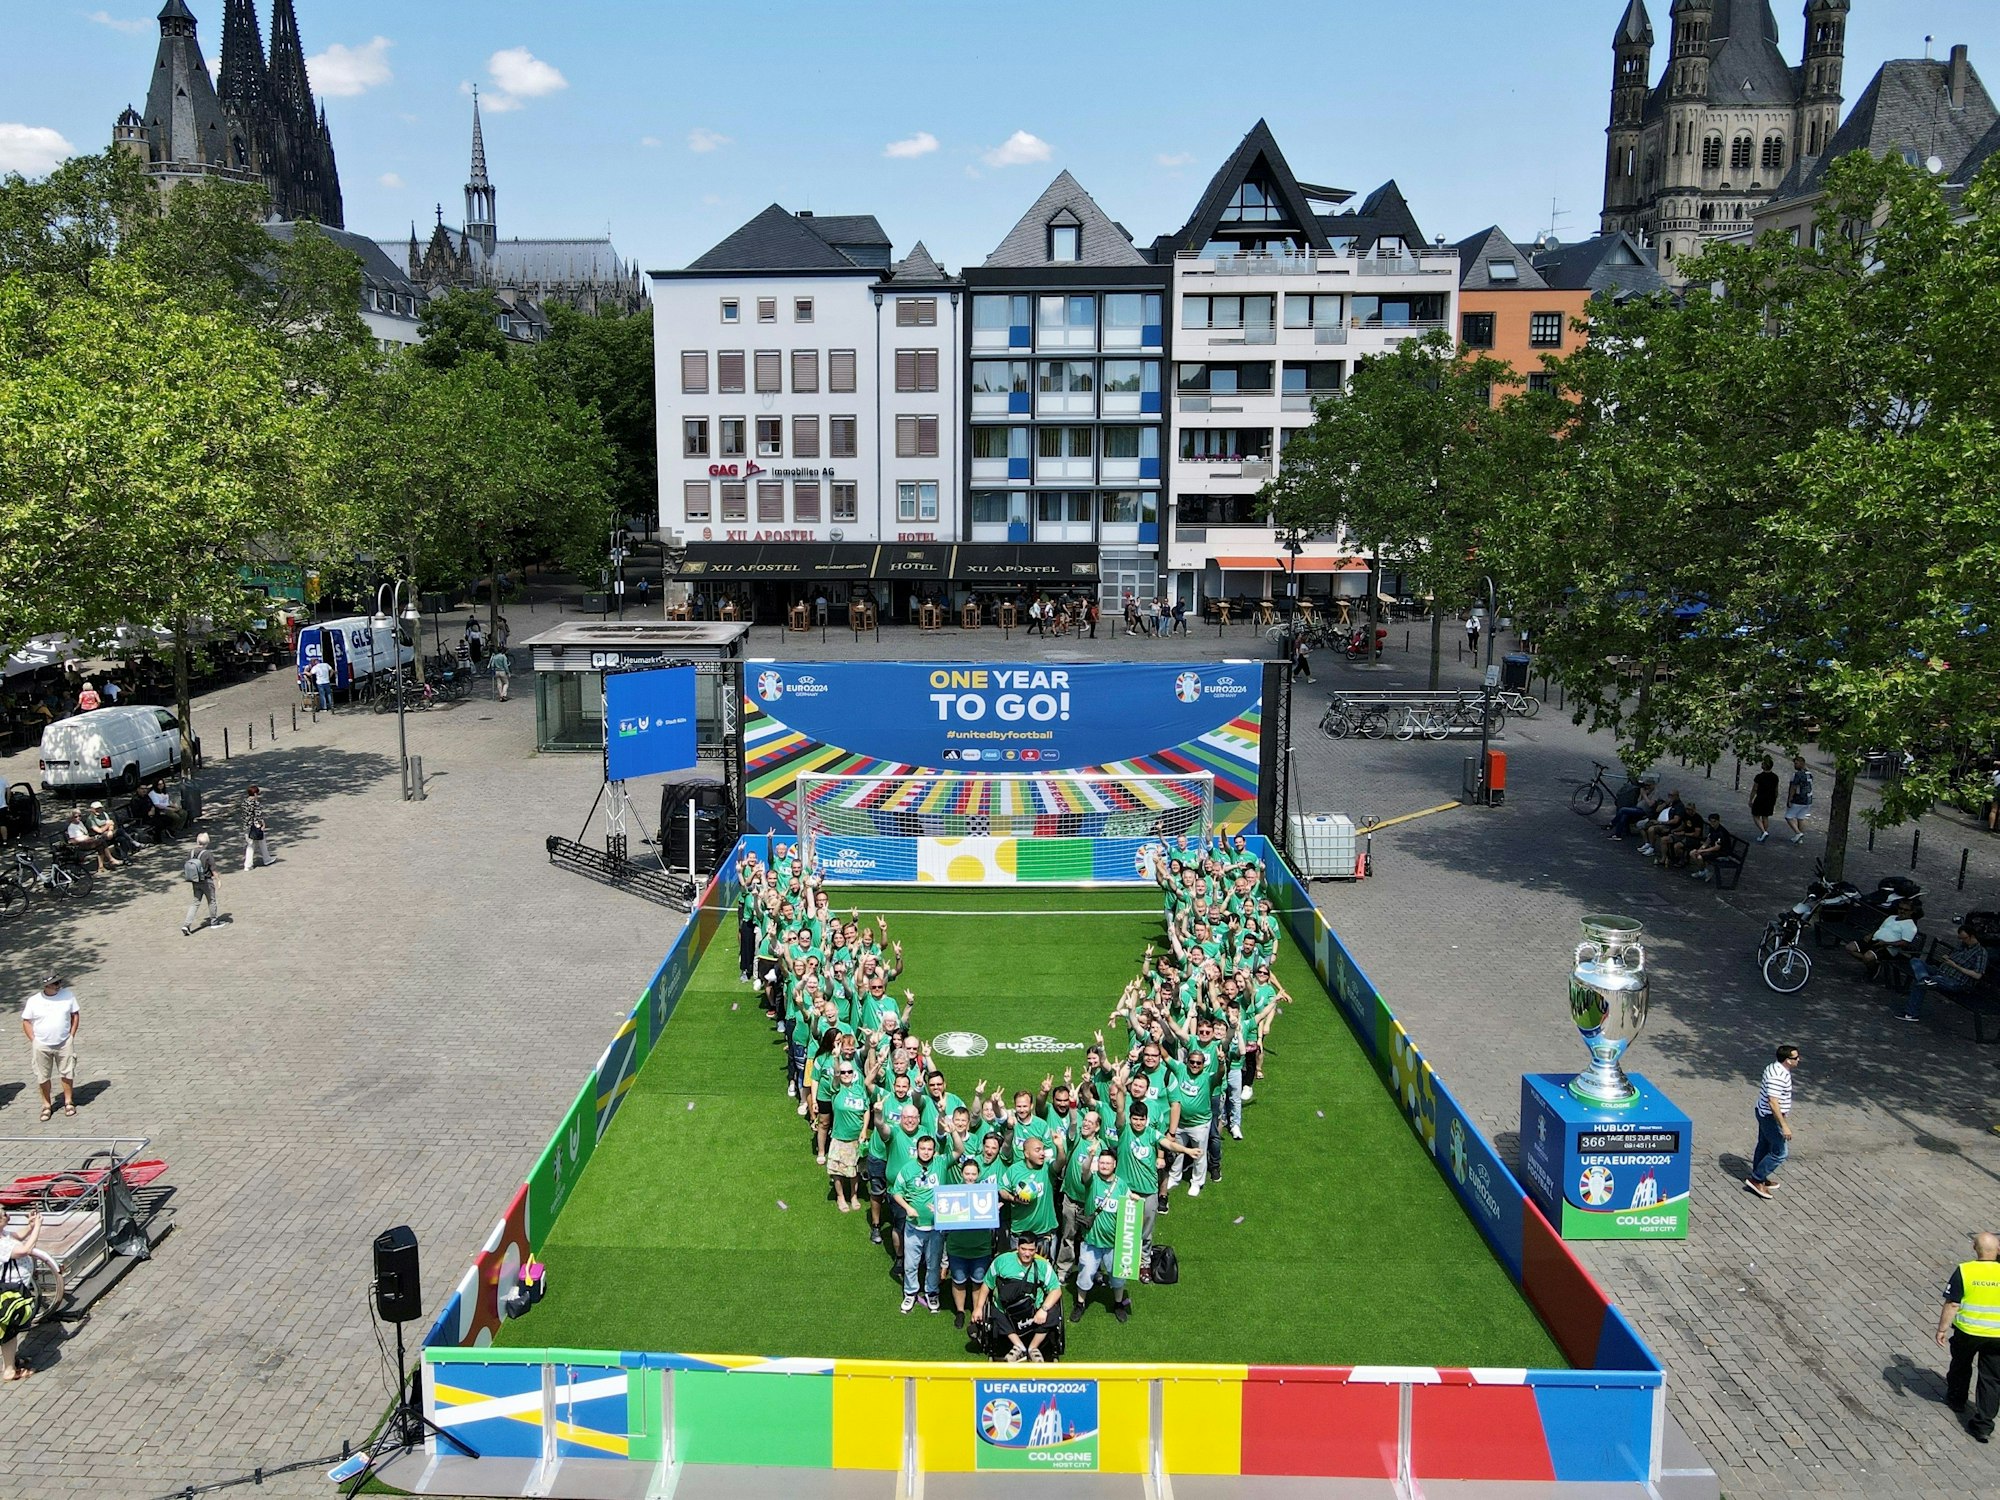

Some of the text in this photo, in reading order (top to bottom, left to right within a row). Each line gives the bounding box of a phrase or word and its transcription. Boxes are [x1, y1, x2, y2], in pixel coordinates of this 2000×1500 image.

[708, 464, 738, 477] GAG
[771, 467, 835, 476] Immobilien AG
[726, 530, 816, 541] XII APOSTEL
[898, 532, 937, 541] HOTEL
[710, 564, 800, 572] XII APOSTEL
[890, 563, 937, 571] HOTEL
[967, 565, 1059, 573] XII APOSTEL
[930, 670, 1070, 689] ONE YEAR
[786, 684, 828, 692] EURO2024
[1204, 685, 1247, 693] EURO2024
[930, 692, 1070, 721] TO GO!
[946, 730, 1053, 741] #unitedbyfootball
[822, 859, 876, 868] EURO2024
[995, 1042, 1085, 1050] EURO2024
[1593, 1124, 1636, 1132] HUBLOT
[1582, 1137, 1605, 1148] 366
[1616, 1216, 1677, 1225] COLOGNE
[1028, 1452, 1092, 1461] COLOGNE
